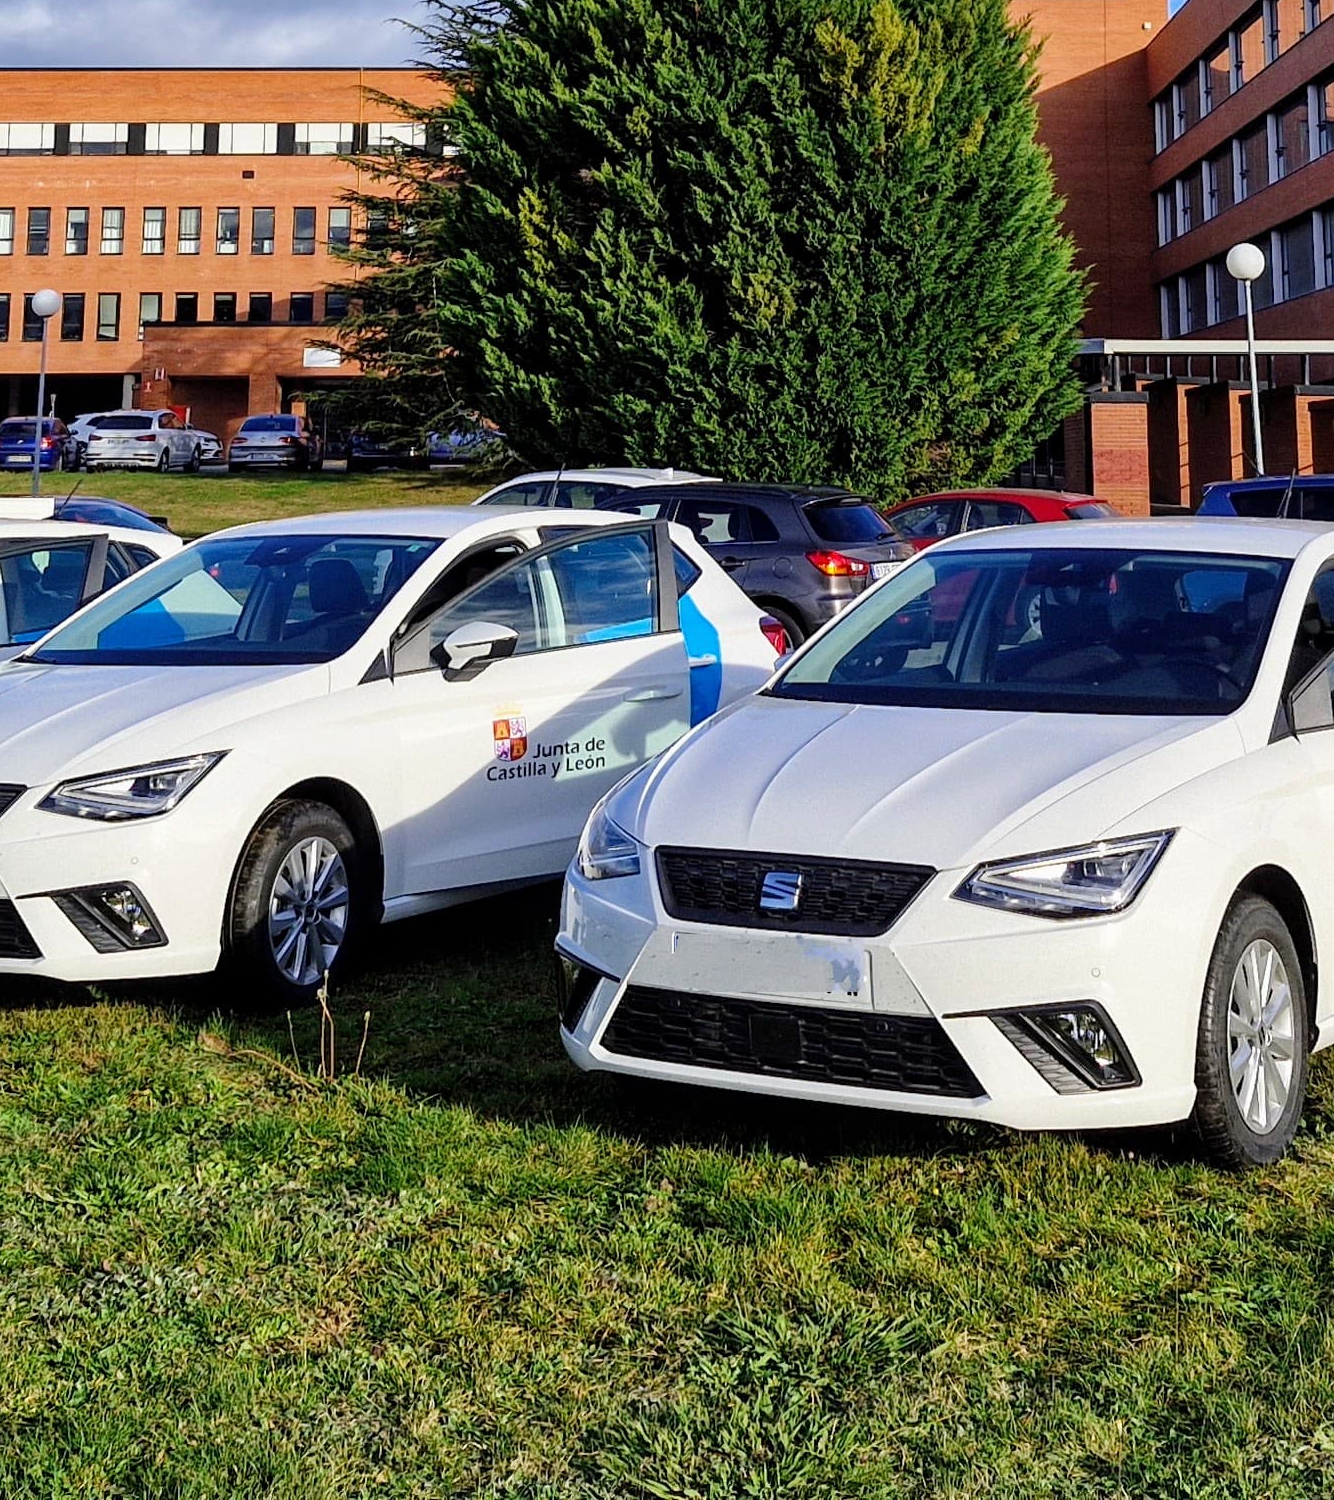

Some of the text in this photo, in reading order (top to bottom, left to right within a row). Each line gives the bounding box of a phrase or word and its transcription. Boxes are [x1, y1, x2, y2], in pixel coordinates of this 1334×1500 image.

[533, 737, 605, 758] Junta de
[487, 754, 605, 781] Castilla y León
